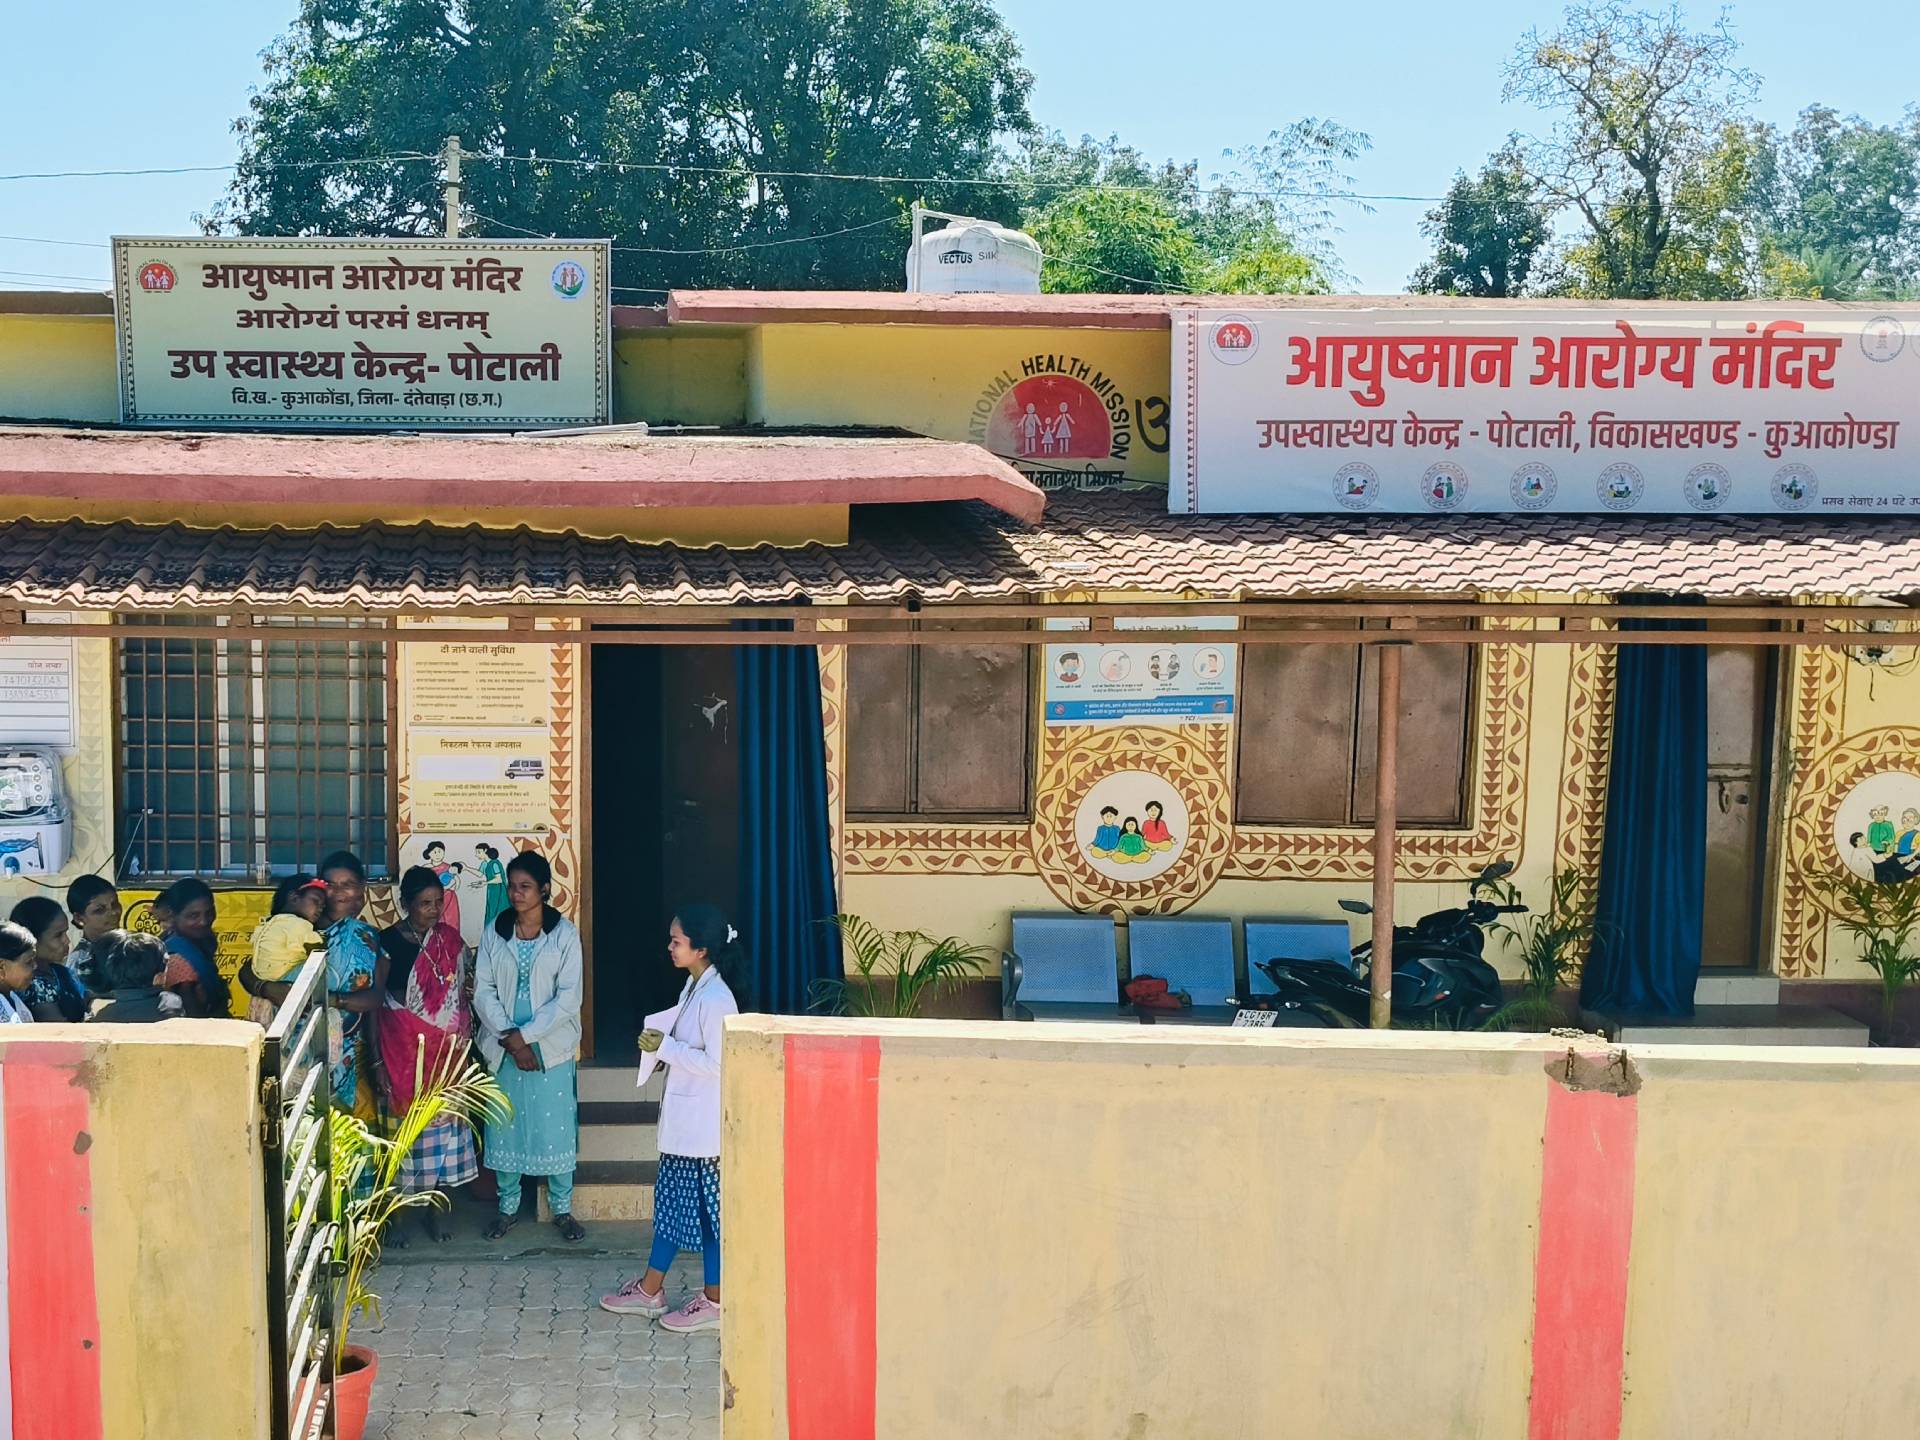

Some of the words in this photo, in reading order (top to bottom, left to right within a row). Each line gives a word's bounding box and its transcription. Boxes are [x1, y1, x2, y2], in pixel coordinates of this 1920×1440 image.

[938, 253, 973, 264] VECTUS
[978, 251, 997, 261] Silk
[202, 263, 334, 300] आयुष्मान
[342, 257, 444, 292] आरोग्य
[452, 258, 523, 292] मंदिर
[236, 303, 338, 330] आरोग्यं
[347, 304, 409, 330] परमं
[417, 310, 492, 339] धनम्
[167, 349, 218, 379] उप
[225, 349, 344, 381] स्वास्थ्य
[449, 341, 561, 382] पोटाली
[1286, 336, 1518, 407] आयुष्मान
[1529, 320, 1702, 388] आरोग्य
[1710, 320, 1842, 389] मंदिर
[281, 386, 354, 410] कुआकोंडा,
[404, 387, 455, 408] दंतेवाड़ा
[458, 390, 502, 408] (छ.ग.)
[1021, 354, 1091, 380] HEALTH
[1090, 371, 1132, 461] MISSION
[1402, 411, 1463, 450] केन्द्र
[1487, 411, 1580, 453] पोटाली,
[1588, 411, 1741, 449] विकासखण्ड
[1764, 412, 1900, 458] कुआकोण्डा
[1876, 497, 1888, 506] 24
[440, 644, 450, 654] दी
[452, 644, 467, 654] जाने
[468, 644, 488, 654] वाली
[490, 645, 515, 656] सुविधा
[440, 739, 468, 749] निकटतम
